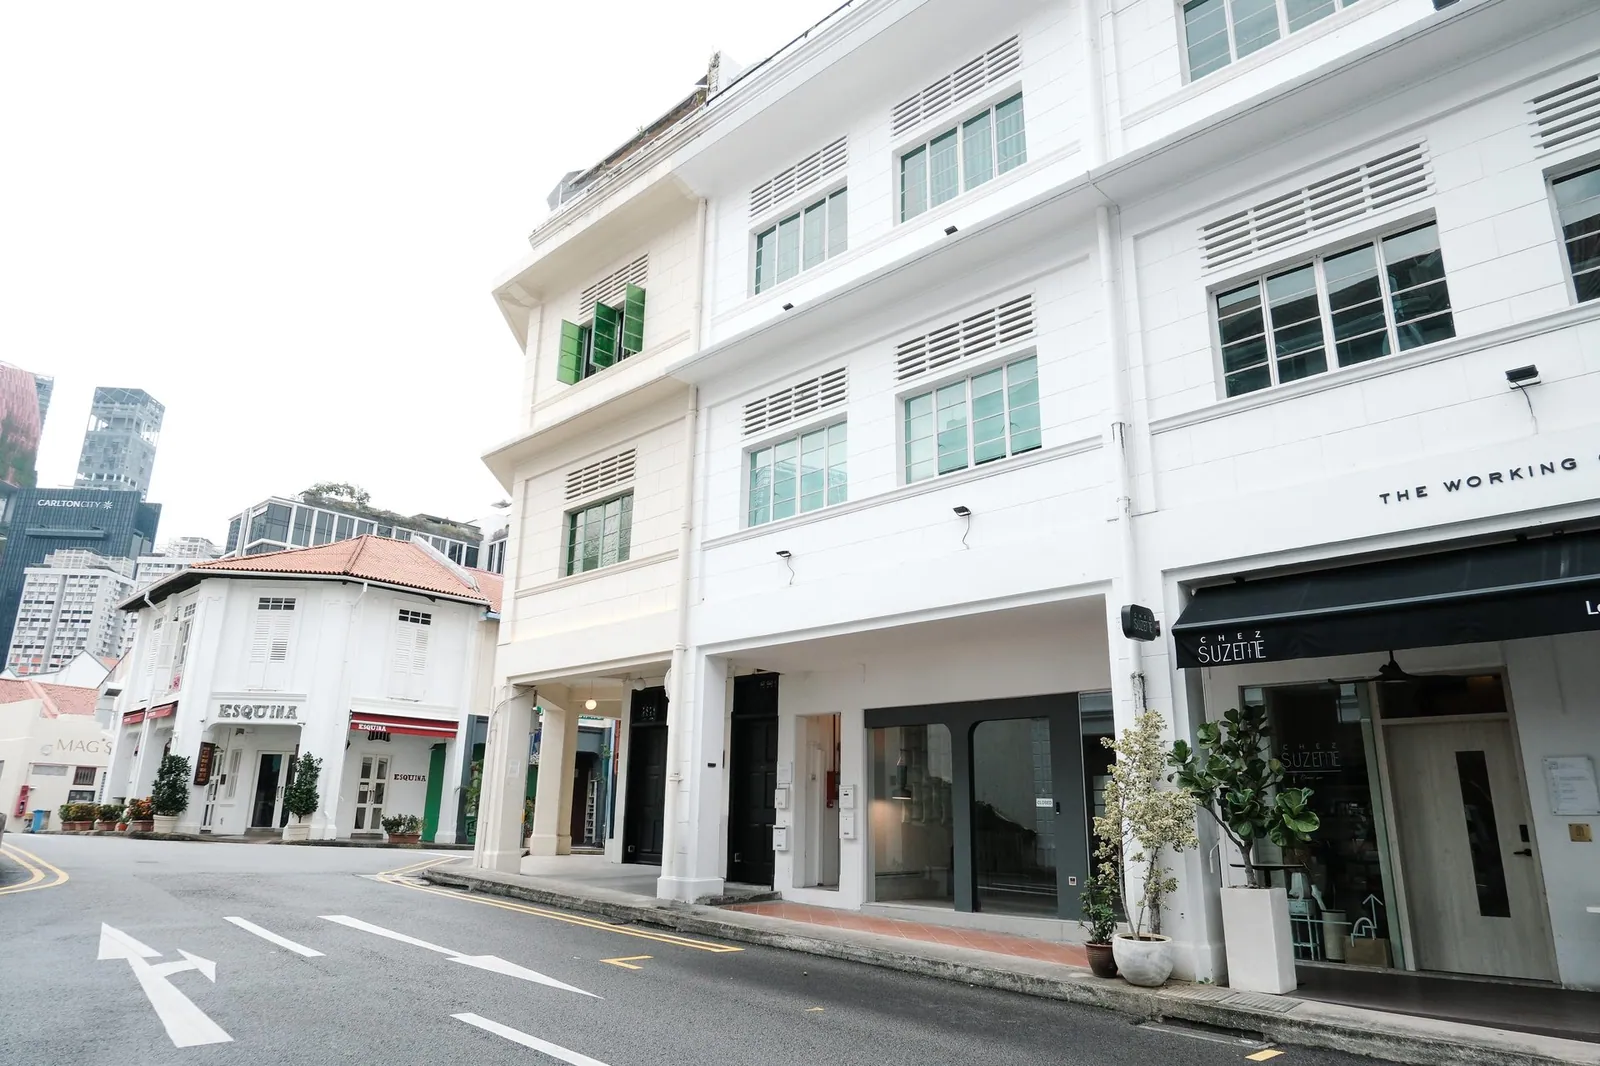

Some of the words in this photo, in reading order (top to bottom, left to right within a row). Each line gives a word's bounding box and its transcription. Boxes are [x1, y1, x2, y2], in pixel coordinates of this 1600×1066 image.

[1379, 485, 1428, 505] THE
[1443, 457, 1577, 493] WORKING
[1199, 630, 1262, 644] CHEZ
[1197, 639, 1267, 664] SUZETTE
[218, 703, 298, 720] ESQUINA
[358, 723, 386, 732] ESQUINA
[1281, 750, 1341, 769] SUZETTE
[393, 773, 427, 782] ESQUINA
